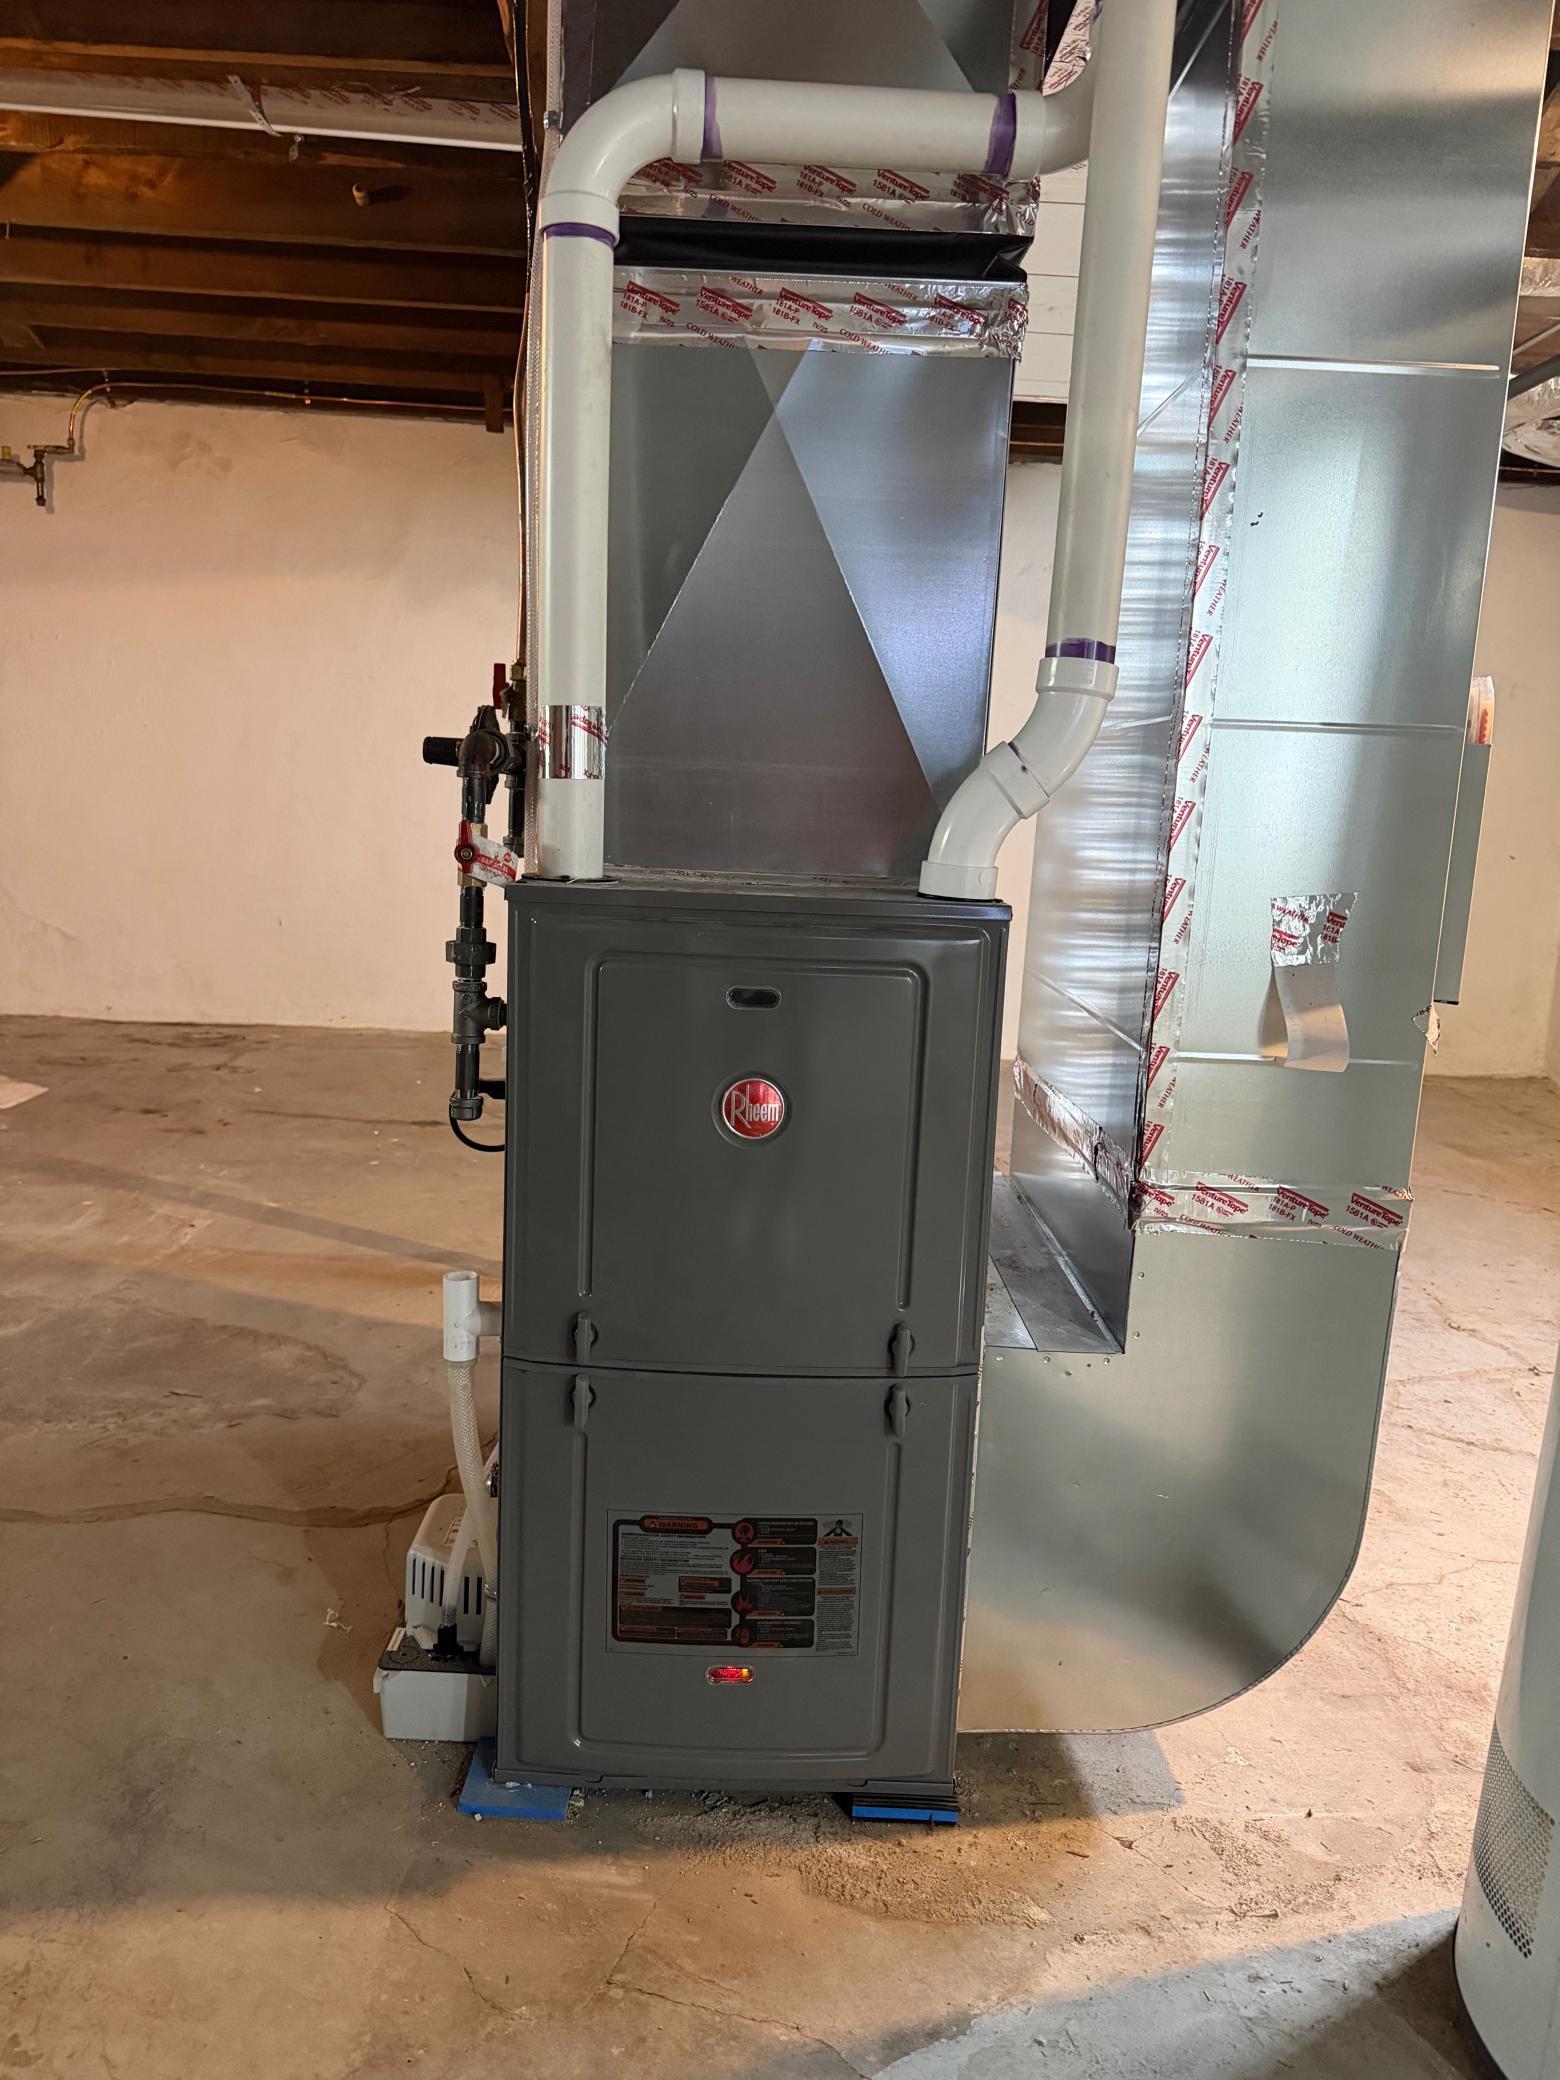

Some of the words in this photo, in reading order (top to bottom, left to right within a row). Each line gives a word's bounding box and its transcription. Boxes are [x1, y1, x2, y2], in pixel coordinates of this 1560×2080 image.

[1236, 81, 1260, 127] Venture
[804, 164, 857, 195] VentureTape
[873, 180, 896, 197] 1581A
[877, 169, 930, 200] VentureTape
[710, 193, 730, 209] COLD
[863, 203, 883, 217] COLD
[1240, 210, 1261, 250] WEATHER
[730, 276, 765, 295] WEATHER
[886, 282, 918, 301] WEATHER
[623, 293, 647, 308] 181A-P
[627, 284, 681, 315] VentureTape
[696, 299, 719, 316] 1581A
[700, 289, 753, 320] VentureTape
[776, 299, 800, 313] 181A-P
[780, 290, 834, 321] VentureTape
[1218, 281, 1243, 326] Venture
[620, 301, 649, 319] 181B-FX
[773, 307, 801, 325] 181B-FX
[850, 305, 873, 322] 1581A
[854, 295, 908, 326] VentureTape
[686, 322, 707, 336] COLD
[840, 329, 860, 342] COLD
[1223, 405, 1244, 444] WEATHER
[1202, 461, 1227, 505] Venture
[1207, 580, 1227, 616] WEATHER
[1190, 748, 1211, 783] WEATHER
[1173, 910, 1194, 945] WEATHER
[1158, 1077, 1177, 1108] WEATHER
[730, 1084, 779, 1129] Rheem
[1228, 1173, 1260, 1191] WEATHER
[1191, 1194, 1215, 1210] 1581A
[1196, 1185, 1249, 1214] VentureTape
[1273, 1196, 1296, 1210] 181A-P
[1277, 1188, 1329, 1219] VentureTape
[1268, 1203, 1297, 1222] 181B-FX
[1345, 1205, 1369, 1222] 1581A
[1351, 1195, 1403, 1226] VentureTape
[1333, 1225, 1353, 1237] COLD
[658, 1521, 698, 1530] WARNING
